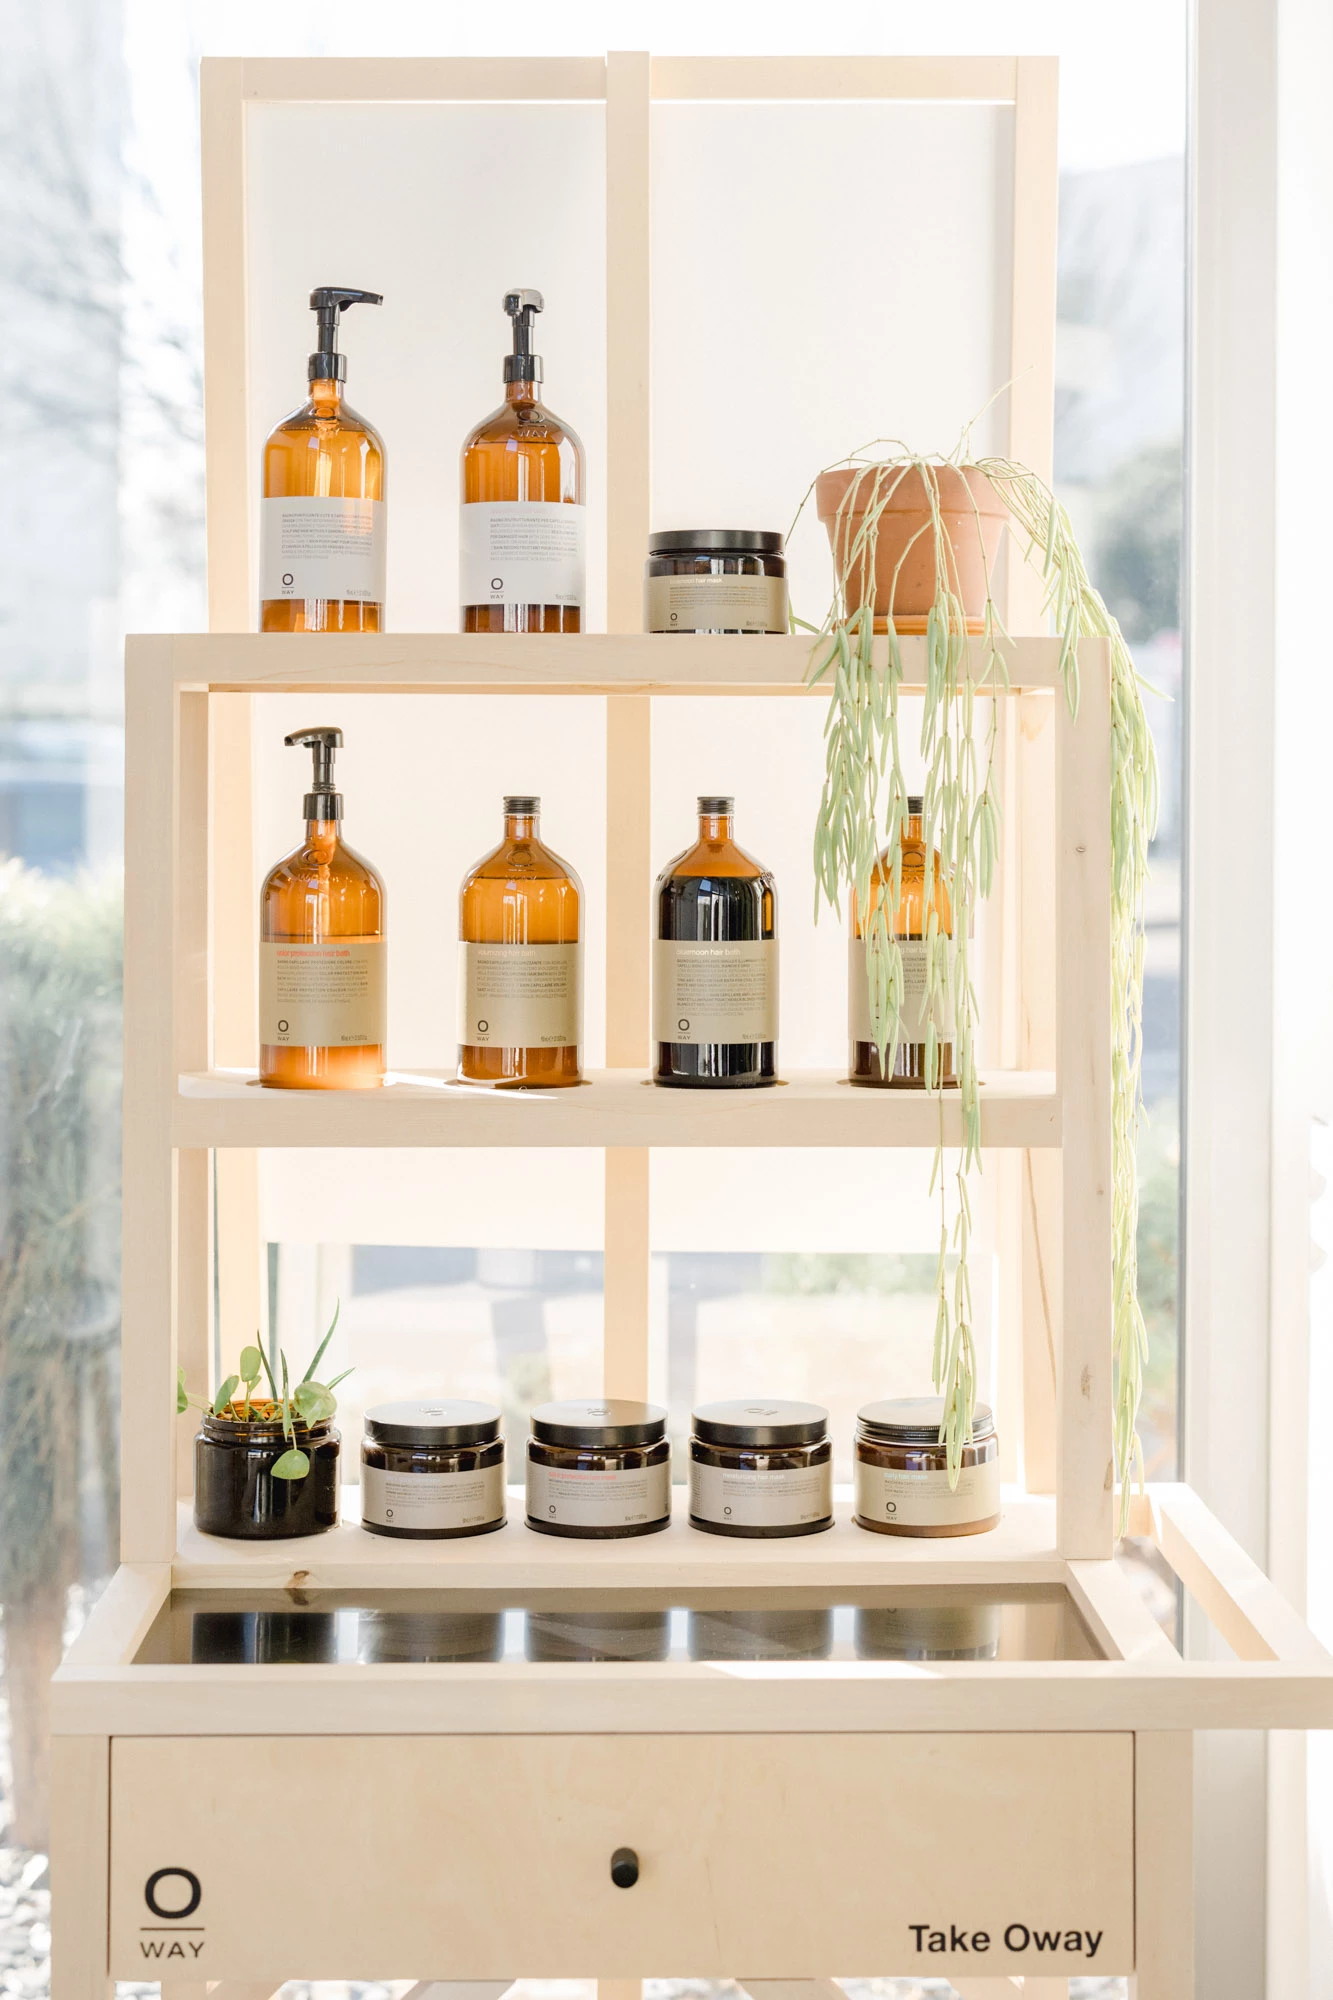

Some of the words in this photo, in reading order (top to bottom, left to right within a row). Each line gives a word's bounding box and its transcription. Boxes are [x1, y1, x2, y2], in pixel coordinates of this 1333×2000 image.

[517, 430, 548, 439] WAY
[282, 573, 294, 586] O
[491, 578, 503, 590] O
[670, 612, 678, 621] O
[710, 948, 724, 956] hair
[278, 1019, 289, 1032] O
[477, 1020, 489, 1032] O
[678, 1018, 690, 1031] O
[386, 1508, 394, 1517] O
[549, 1505, 556, 1513] O
[724, 1506, 732, 1515] O
[886, 1502, 897, 1512] O
[145, 1867, 201, 1919] O
[908, 1924, 991, 1952] Take
[1004, 1923, 1103, 1958] Oway
[140, 1941, 204, 1958] WAY
